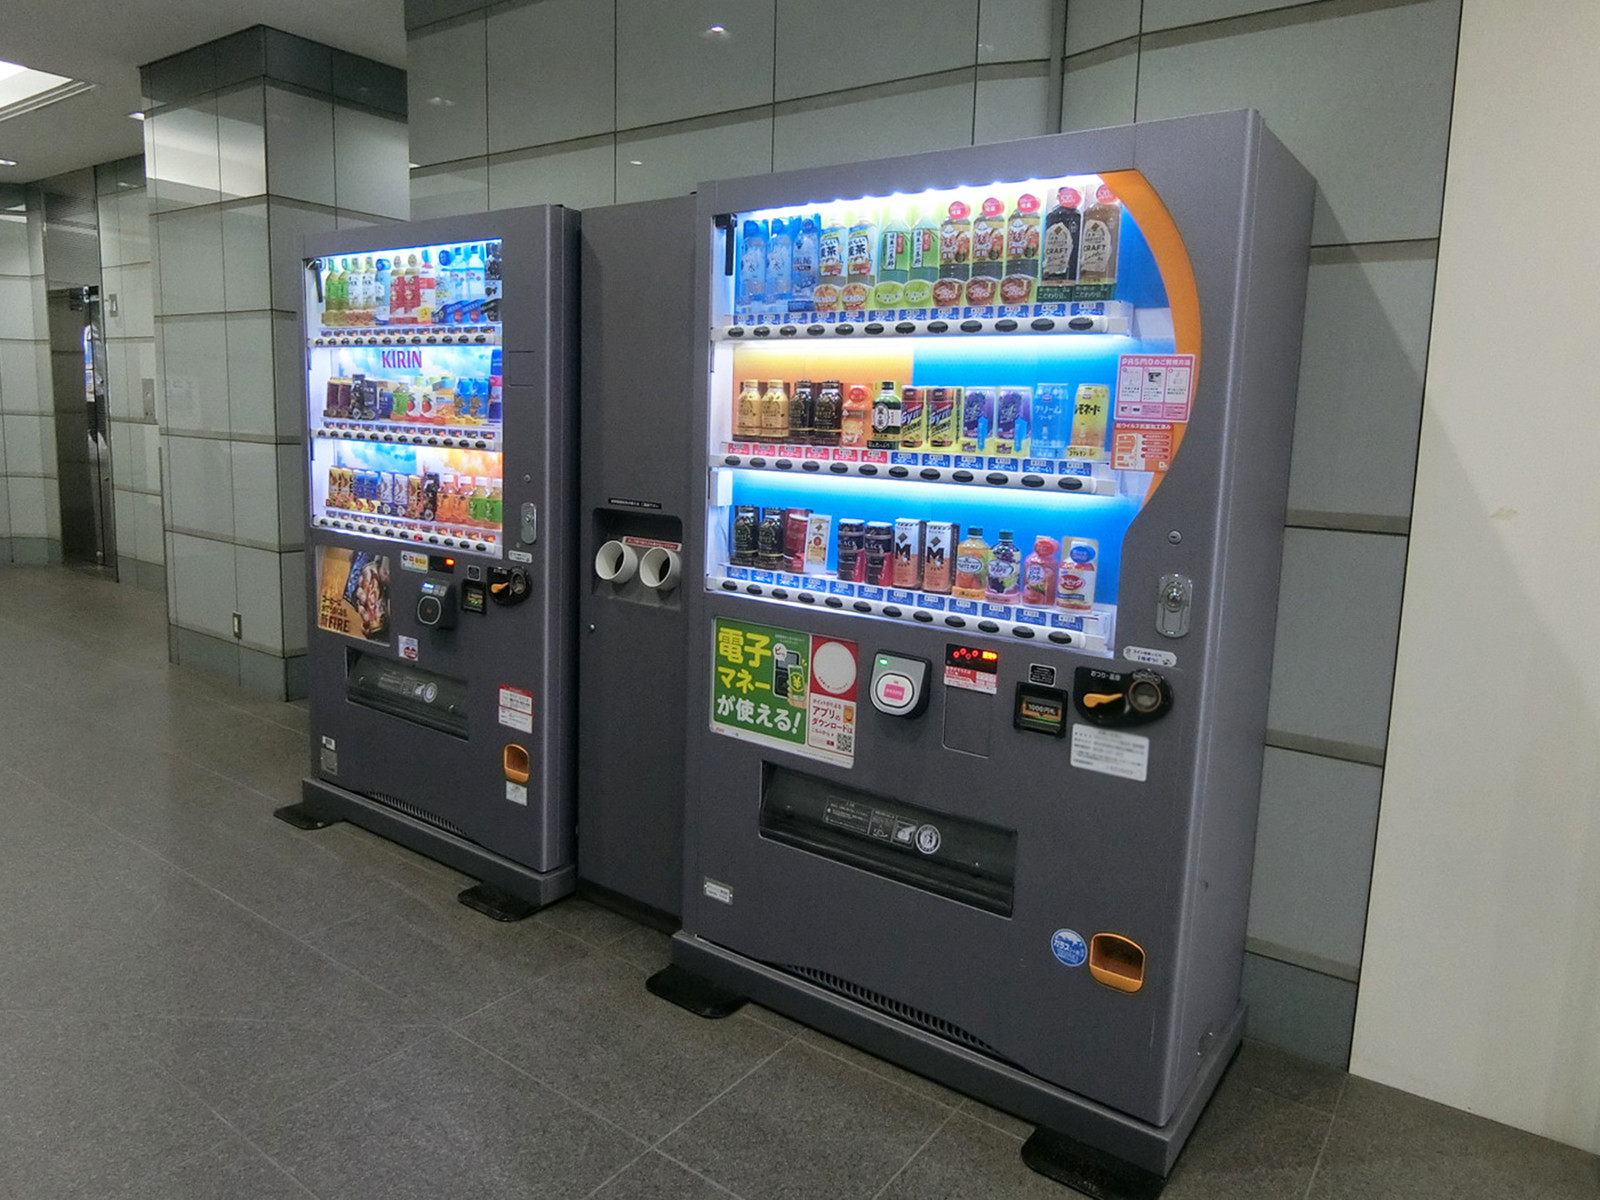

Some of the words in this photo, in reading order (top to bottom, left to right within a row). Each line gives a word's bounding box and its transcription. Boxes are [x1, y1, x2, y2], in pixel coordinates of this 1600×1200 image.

[1046, 247, 1068, 255] CRAFT
[1083, 244, 1106, 252] CRAFT
[382, 350, 422, 368] KIRIN
[328, 616, 349, 632] FIRE
[718, 627, 772, 668] 電子
[718, 666, 770, 694] マネー
[717, 694, 802, 734] が使える!
[812, 706, 841, 721] アプリの
[812, 718, 853, 734] ダウンロードは
